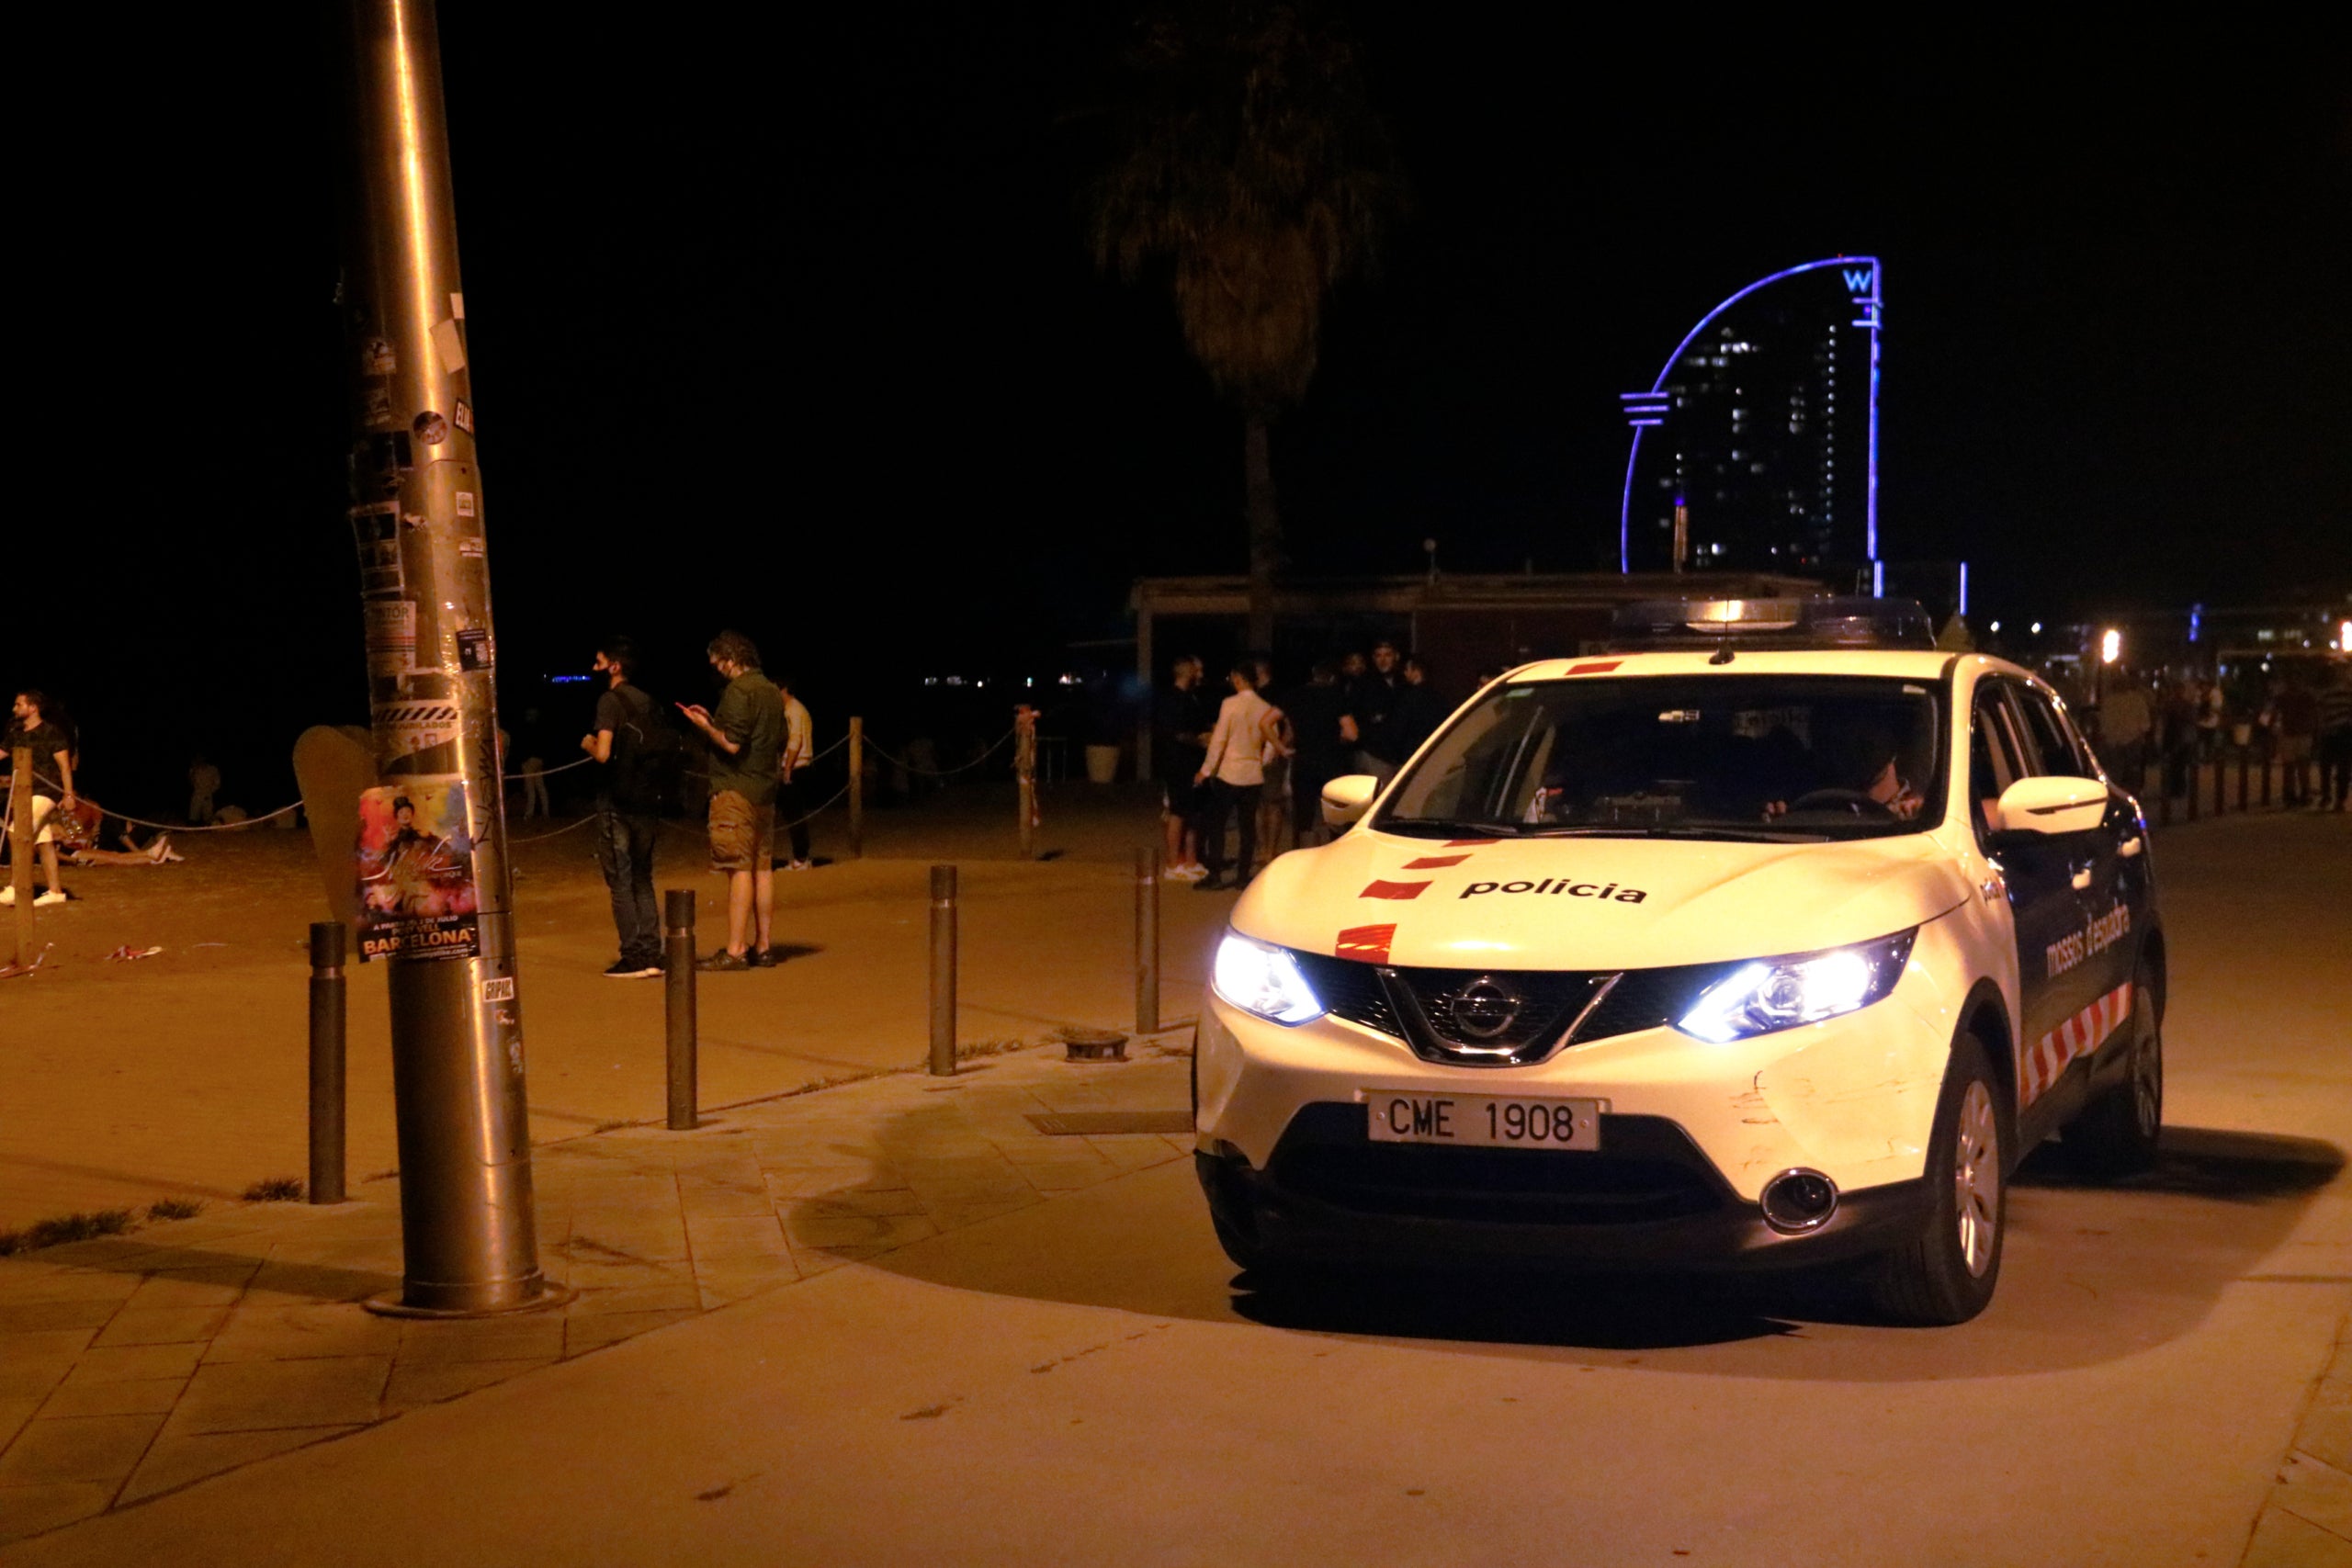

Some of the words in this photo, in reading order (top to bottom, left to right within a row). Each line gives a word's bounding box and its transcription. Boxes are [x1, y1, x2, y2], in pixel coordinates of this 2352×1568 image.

[1843, 269, 1871, 292] W
[1459, 878, 1647, 904] policia
[363, 929, 471, 955] BARCELONA
[2046, 931, 2083, 978] mossos
[1389, 1099, 1454, 1137] CME
[1486, 1103, 1573, 1142] 1908
